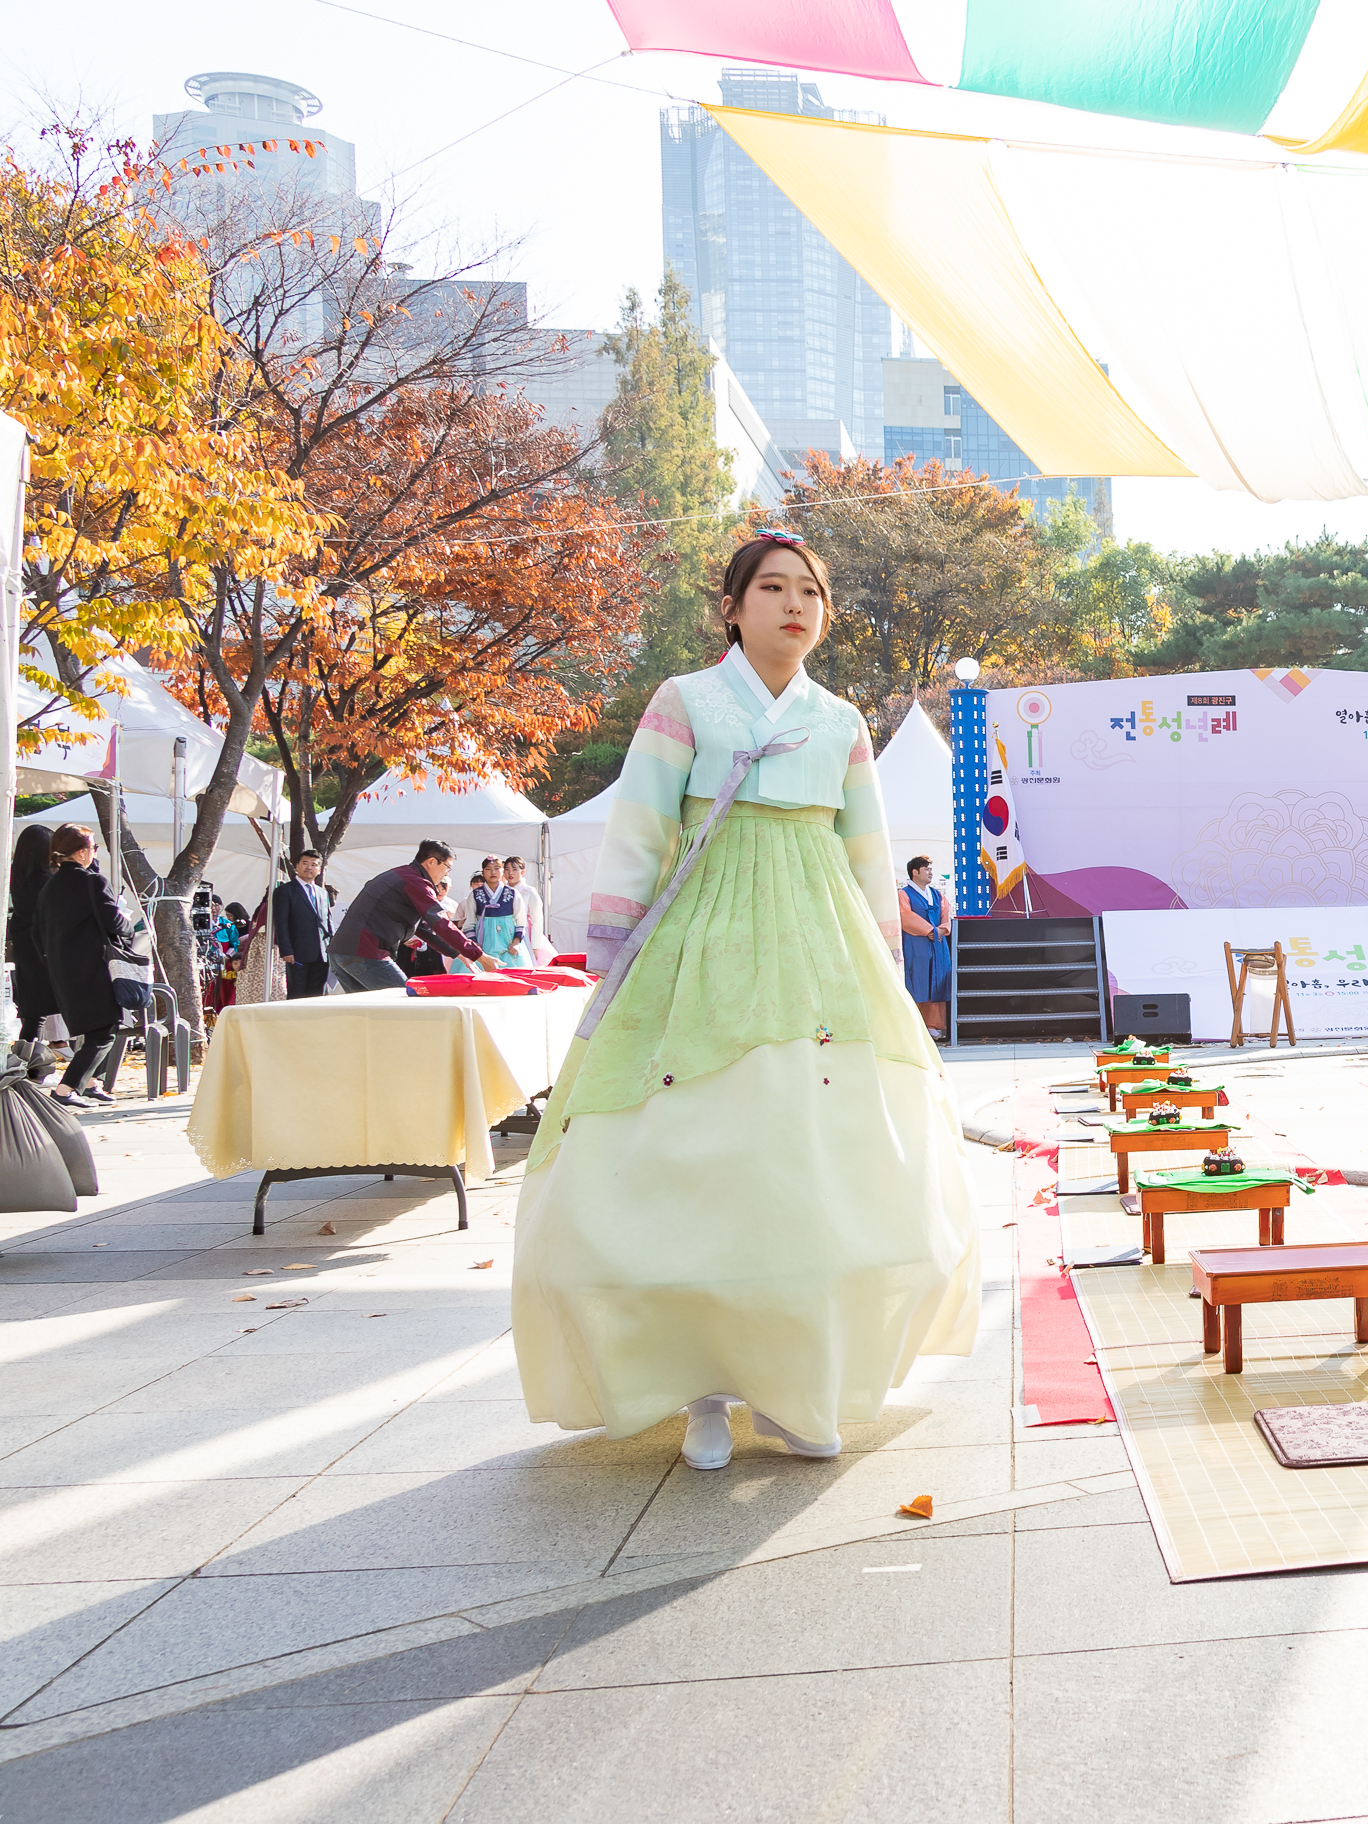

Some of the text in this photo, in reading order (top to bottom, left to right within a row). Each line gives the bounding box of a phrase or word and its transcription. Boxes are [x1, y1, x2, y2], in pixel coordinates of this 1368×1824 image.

[1190, 696, 1232, 705] 제8회 광진구
[1109, 700, 1238, 742] 전통성년례
